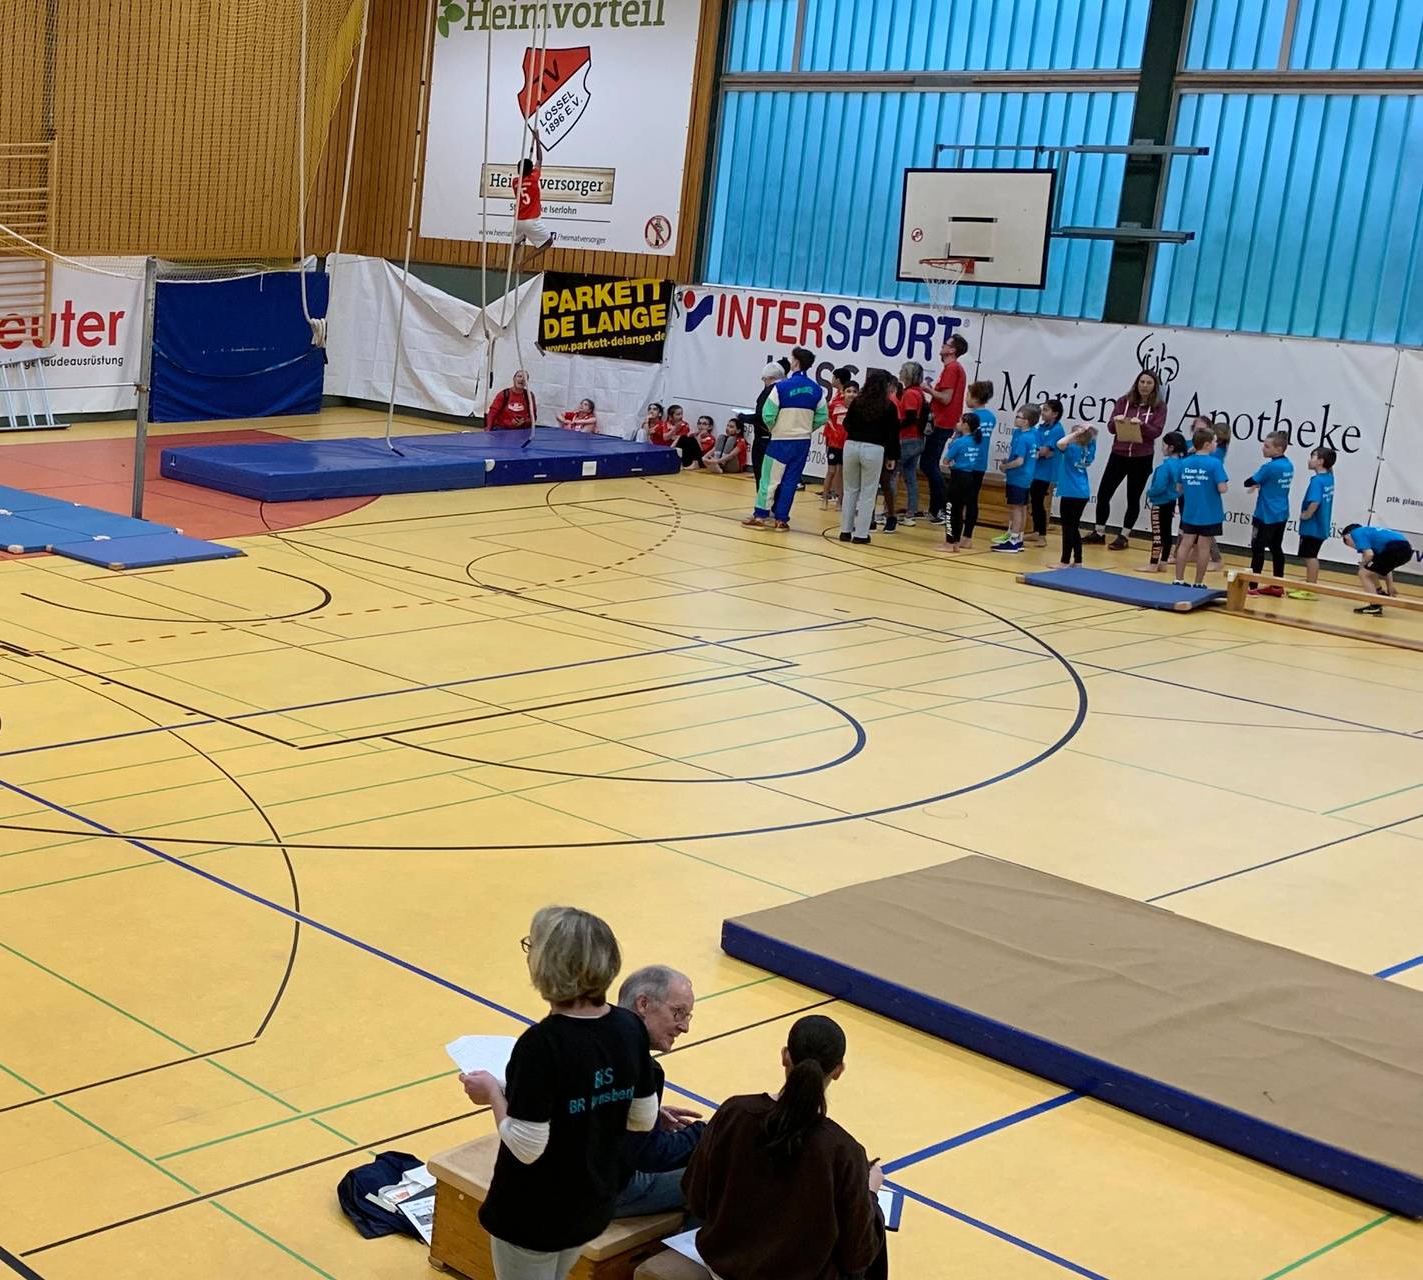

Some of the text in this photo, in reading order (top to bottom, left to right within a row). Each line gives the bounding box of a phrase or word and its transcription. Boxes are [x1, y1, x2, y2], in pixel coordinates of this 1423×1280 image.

[463, 0, 665, 31] Heimvorteil
[539, 91, 575, 127] LÖSSEL
[544, 113, 565, 135] 1896
[489, 173, 604, 196] Heiversorger
[549, 204, 577, 215] Iserlohn
[542, 278, 661, 315] PARKETT
[543, 303, 667, 340] DE LANGE
[716, 293, 962, 362] INTERSPORT
[1175, 392, 1362, 453] Apotheke
